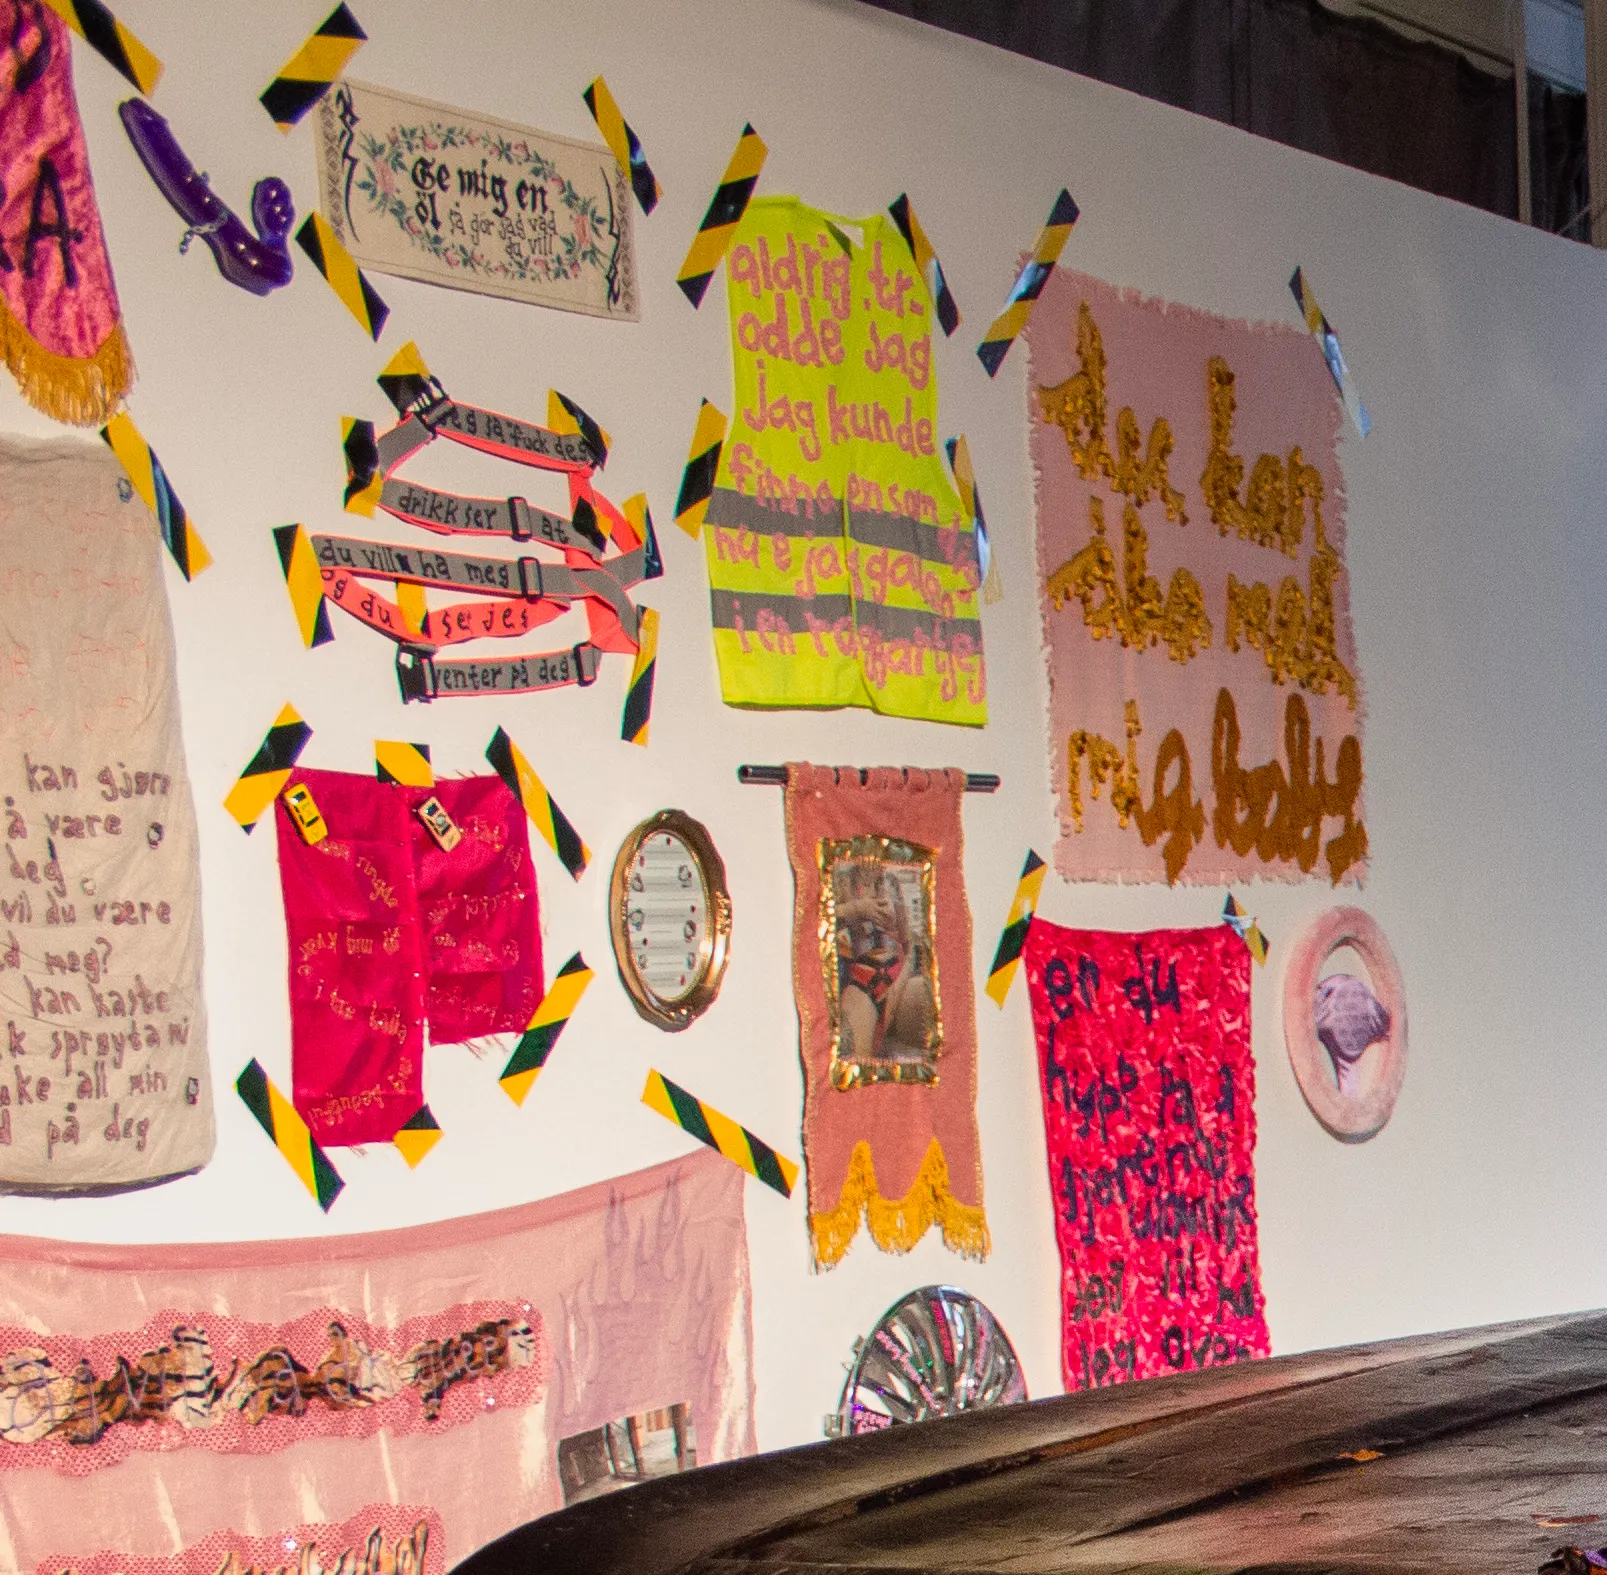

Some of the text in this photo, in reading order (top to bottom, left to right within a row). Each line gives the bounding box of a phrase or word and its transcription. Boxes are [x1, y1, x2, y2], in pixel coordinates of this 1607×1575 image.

[411, 157, 548, 217] Ge mig en
[415, 191, 441, 230] öl
[729, 233, 851, 320] aldrig
[738, 293, 931, 391] odde jag
[743, 358, 935, 462] jag kunde
[319, 539, 356, 567] du
[419, 551, 450, 579] ha
[465, 562, 509, 588] meg
[772, 532, 791, 572] e
[361, 594, 394, 628] du
[756, 607, 797, 655] en
[435, 658, 569, 690] venter på deg
[24, 753, 78, 792] kan
[5, 796, 122, 838] å være
[5, 840, 67, 897] deg
[46, 891, 76, 924] du
[94, 900, 171, 925] være
[24, 975, 81, 1019] kan
[78, 1060, 108, 1099] all
[48, 1102, 80, 1160] på
[104, 1103, 149, 1151] deg
